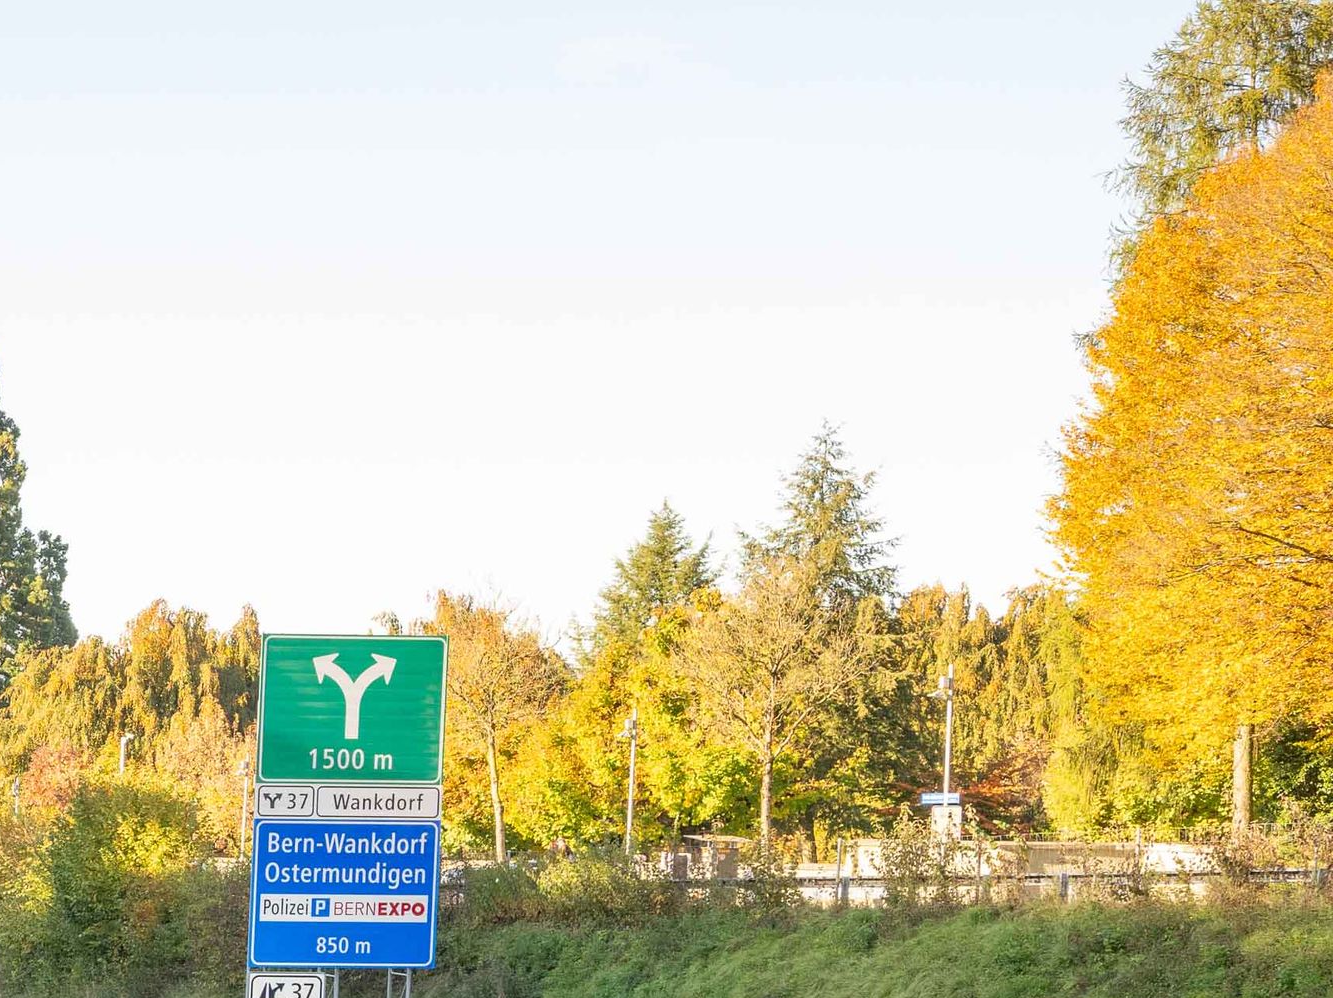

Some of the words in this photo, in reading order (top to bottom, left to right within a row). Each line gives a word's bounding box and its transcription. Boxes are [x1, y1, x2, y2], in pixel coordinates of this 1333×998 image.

[308, 748, 365, 770] 1500
[373, 753, 393, 770] m
[286, 792, 309, 810] 37
[332, 792, 425, 811] Wankdorf
[267, 831, 429, 855] Bern-Wankdorf
[264, 861, 427, 890] Ostermundigen
[262, 897, 309, 916] Polizei
[315, 936, 350, 955] 850
[355, 940, 372, 955] m
